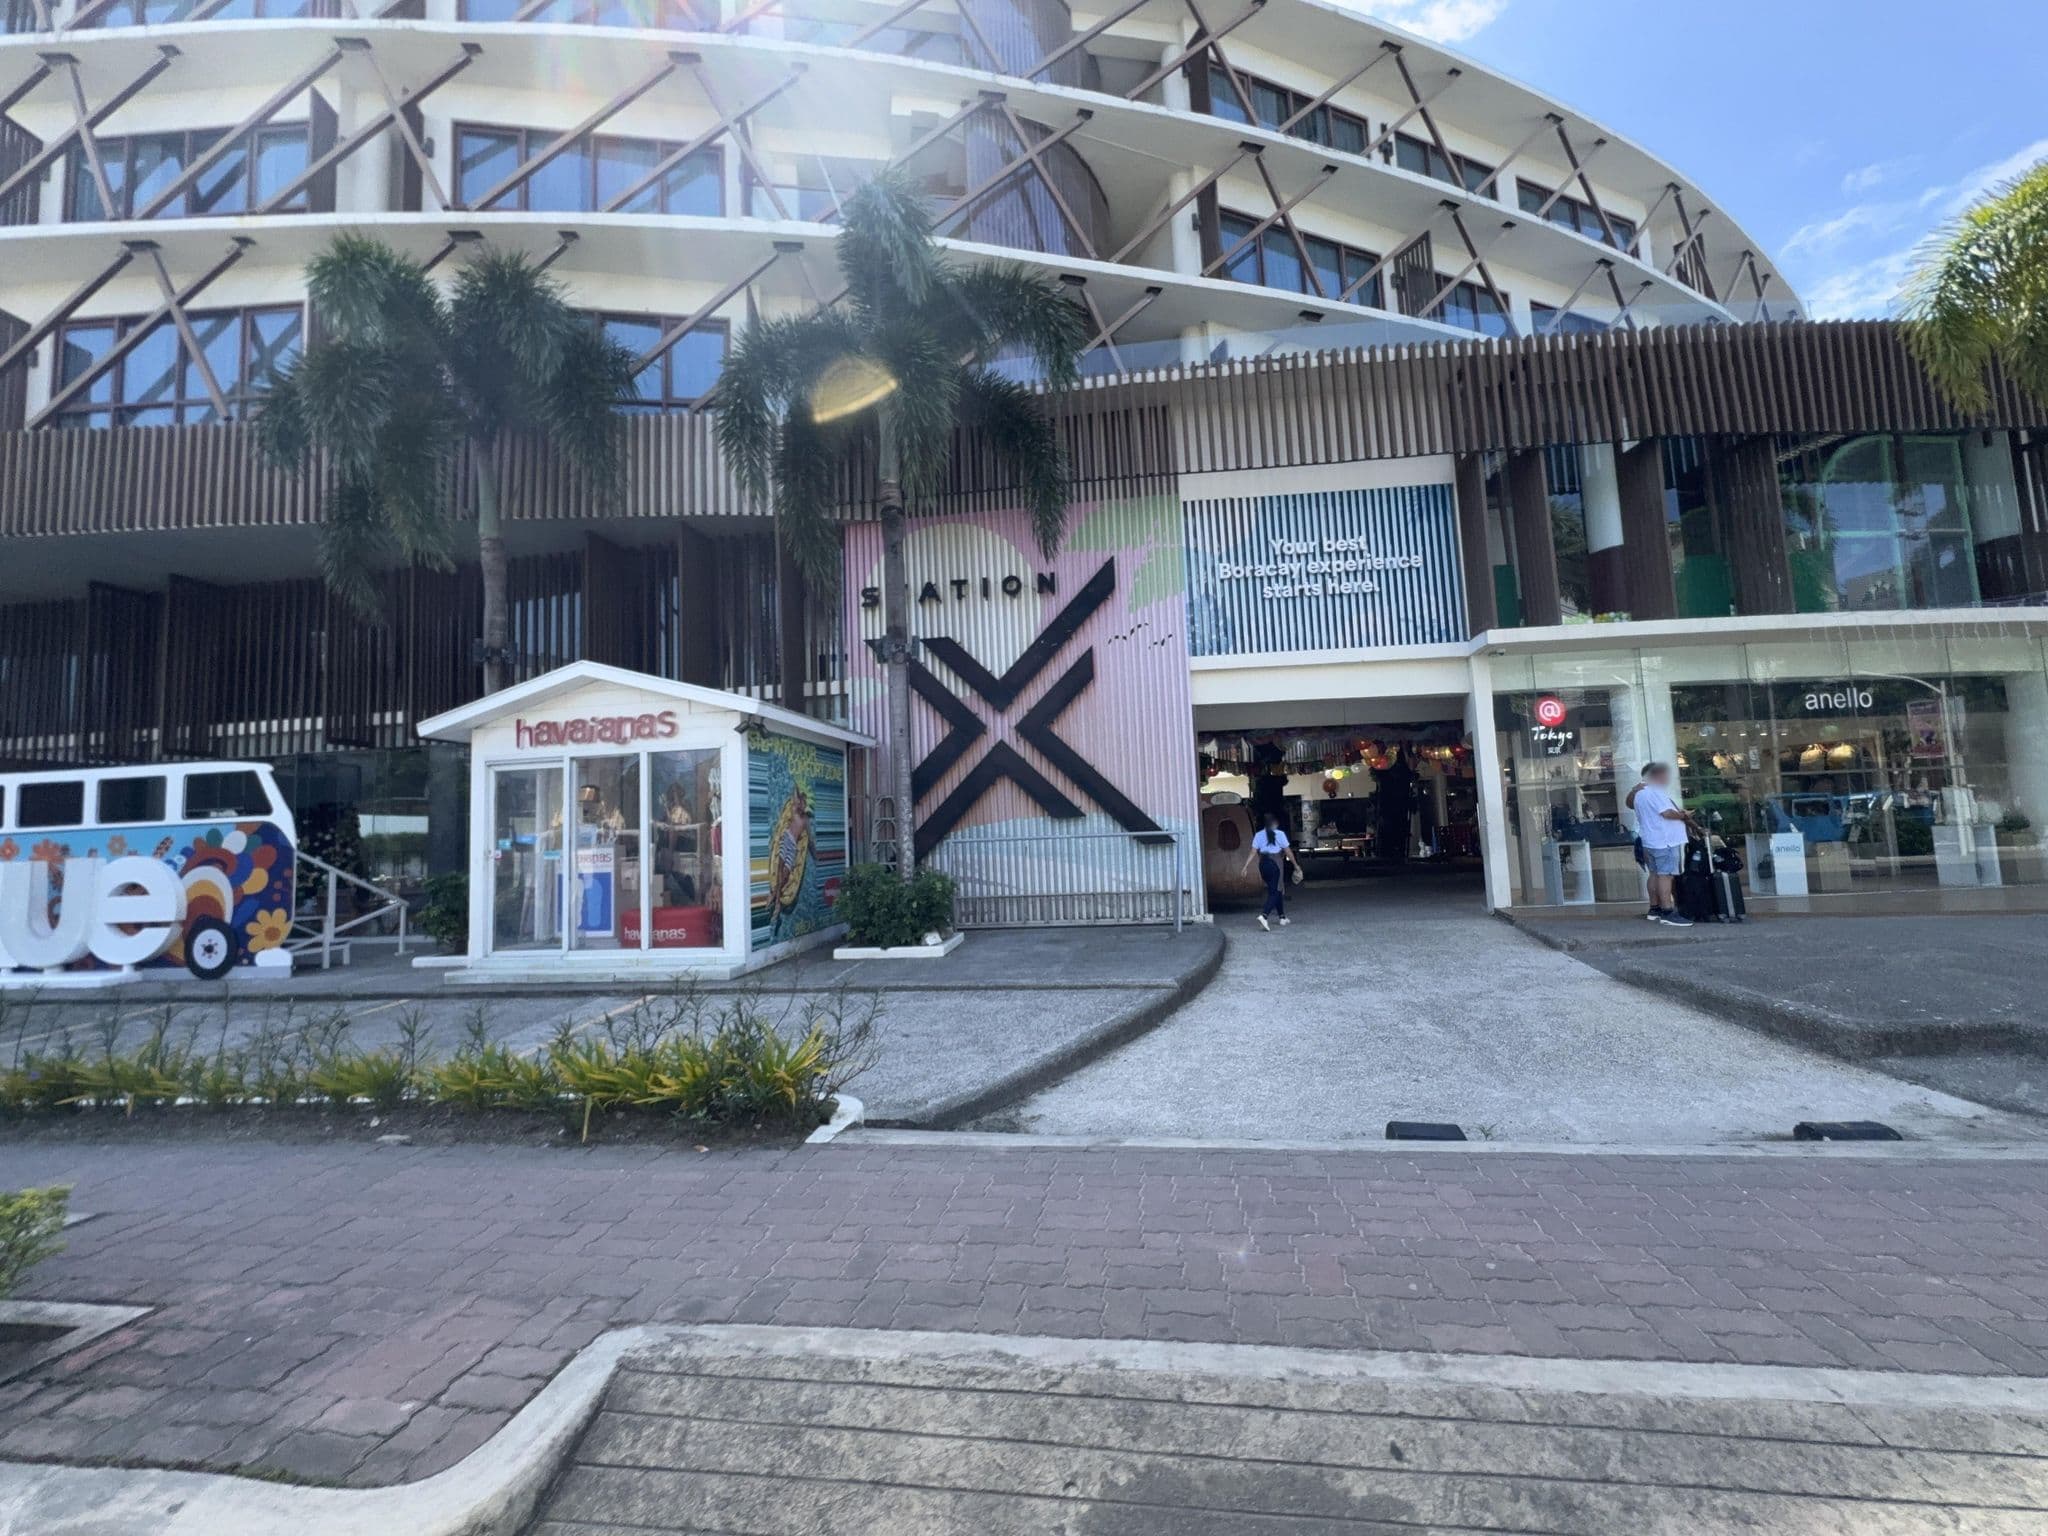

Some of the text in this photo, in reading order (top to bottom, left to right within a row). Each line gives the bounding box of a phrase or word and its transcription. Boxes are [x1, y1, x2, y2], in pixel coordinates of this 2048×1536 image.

[1270, 535, 1367, 555] Your best
[1219, 552, 1424, 579] Boracay experience
[861, 571, 1056, 608] SATION
[1263, 576, 1380, 599] starts here.
[1804, 687, 1873, 710] anello
[515, 711, 679, 748] havaianas
[1531, 726, 1573, 747] Tokyo
